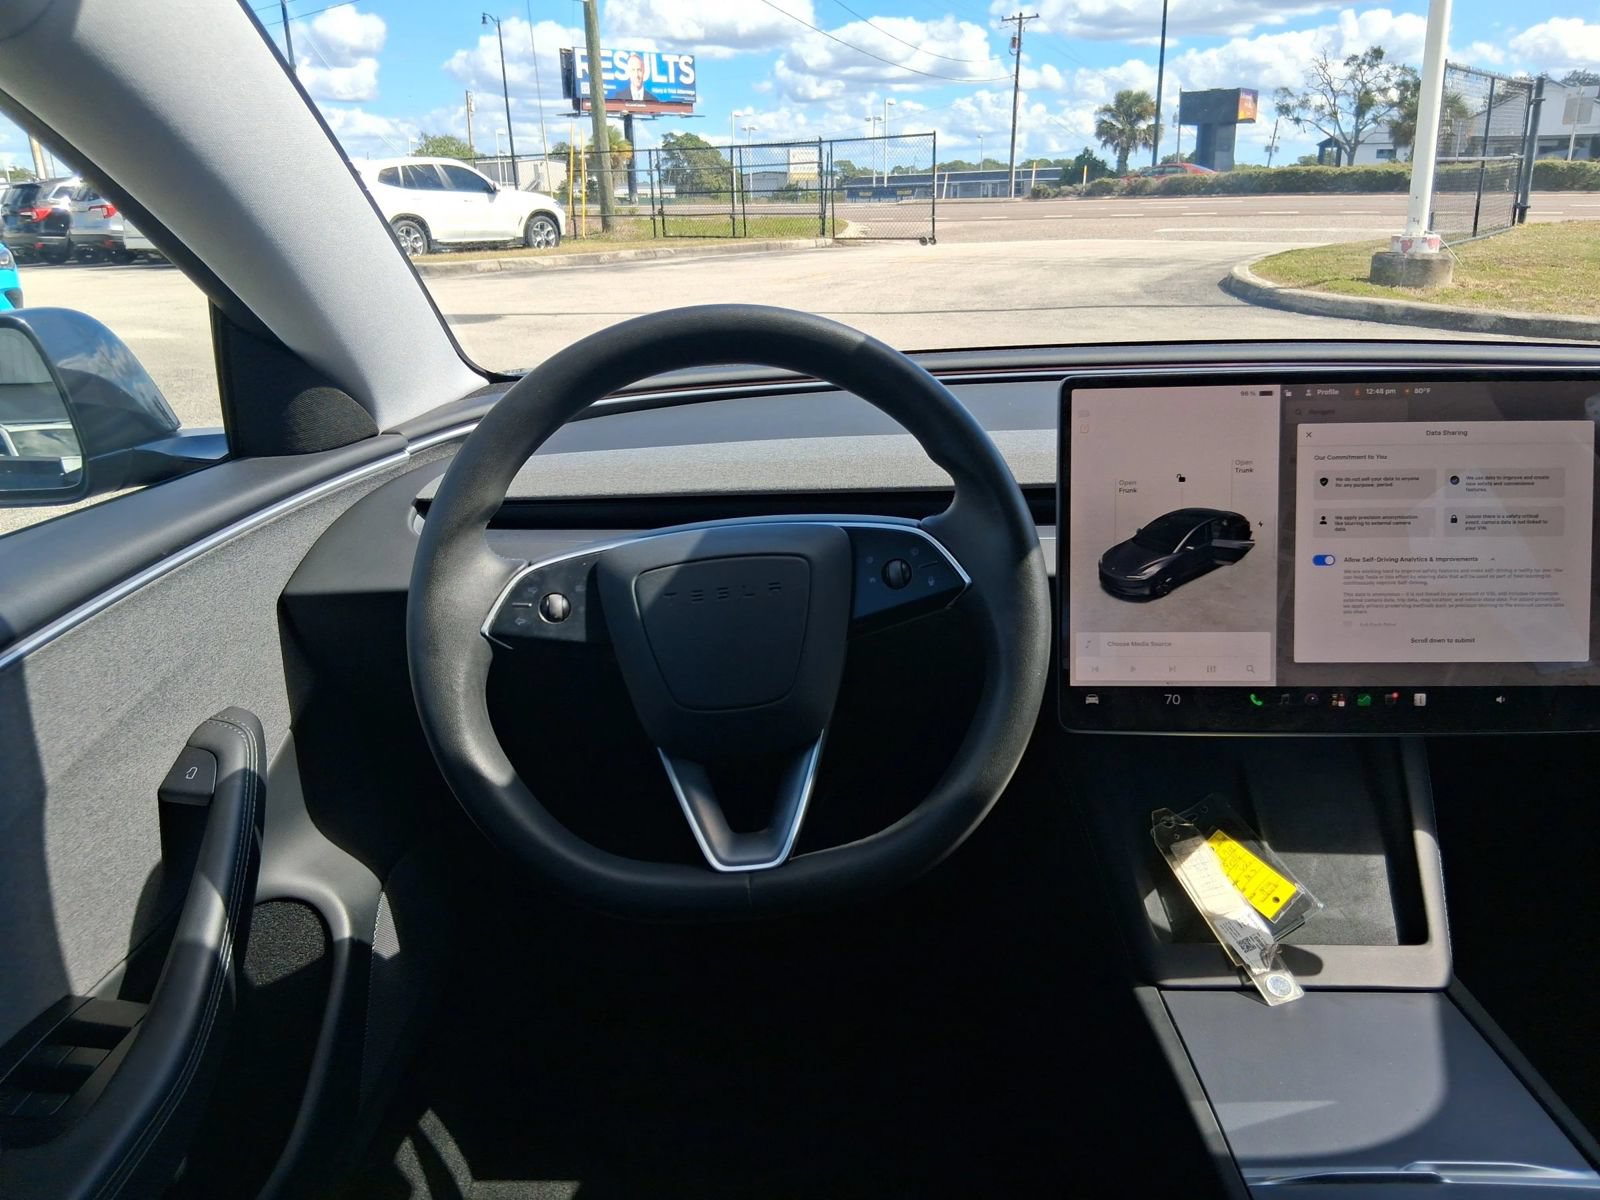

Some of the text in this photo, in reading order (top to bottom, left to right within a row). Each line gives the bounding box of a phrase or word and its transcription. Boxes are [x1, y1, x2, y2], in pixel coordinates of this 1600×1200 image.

[1317, 388, 1340, 396] Profile
[1443, 429, 1468, 437] Sharing
[1235, 459, 1253, 467] Open
[1118, 479, 1137, 488] Open
[1362, 556, 1399, 564] Self-Driving
[1164, 694, 1181, 705] 70
